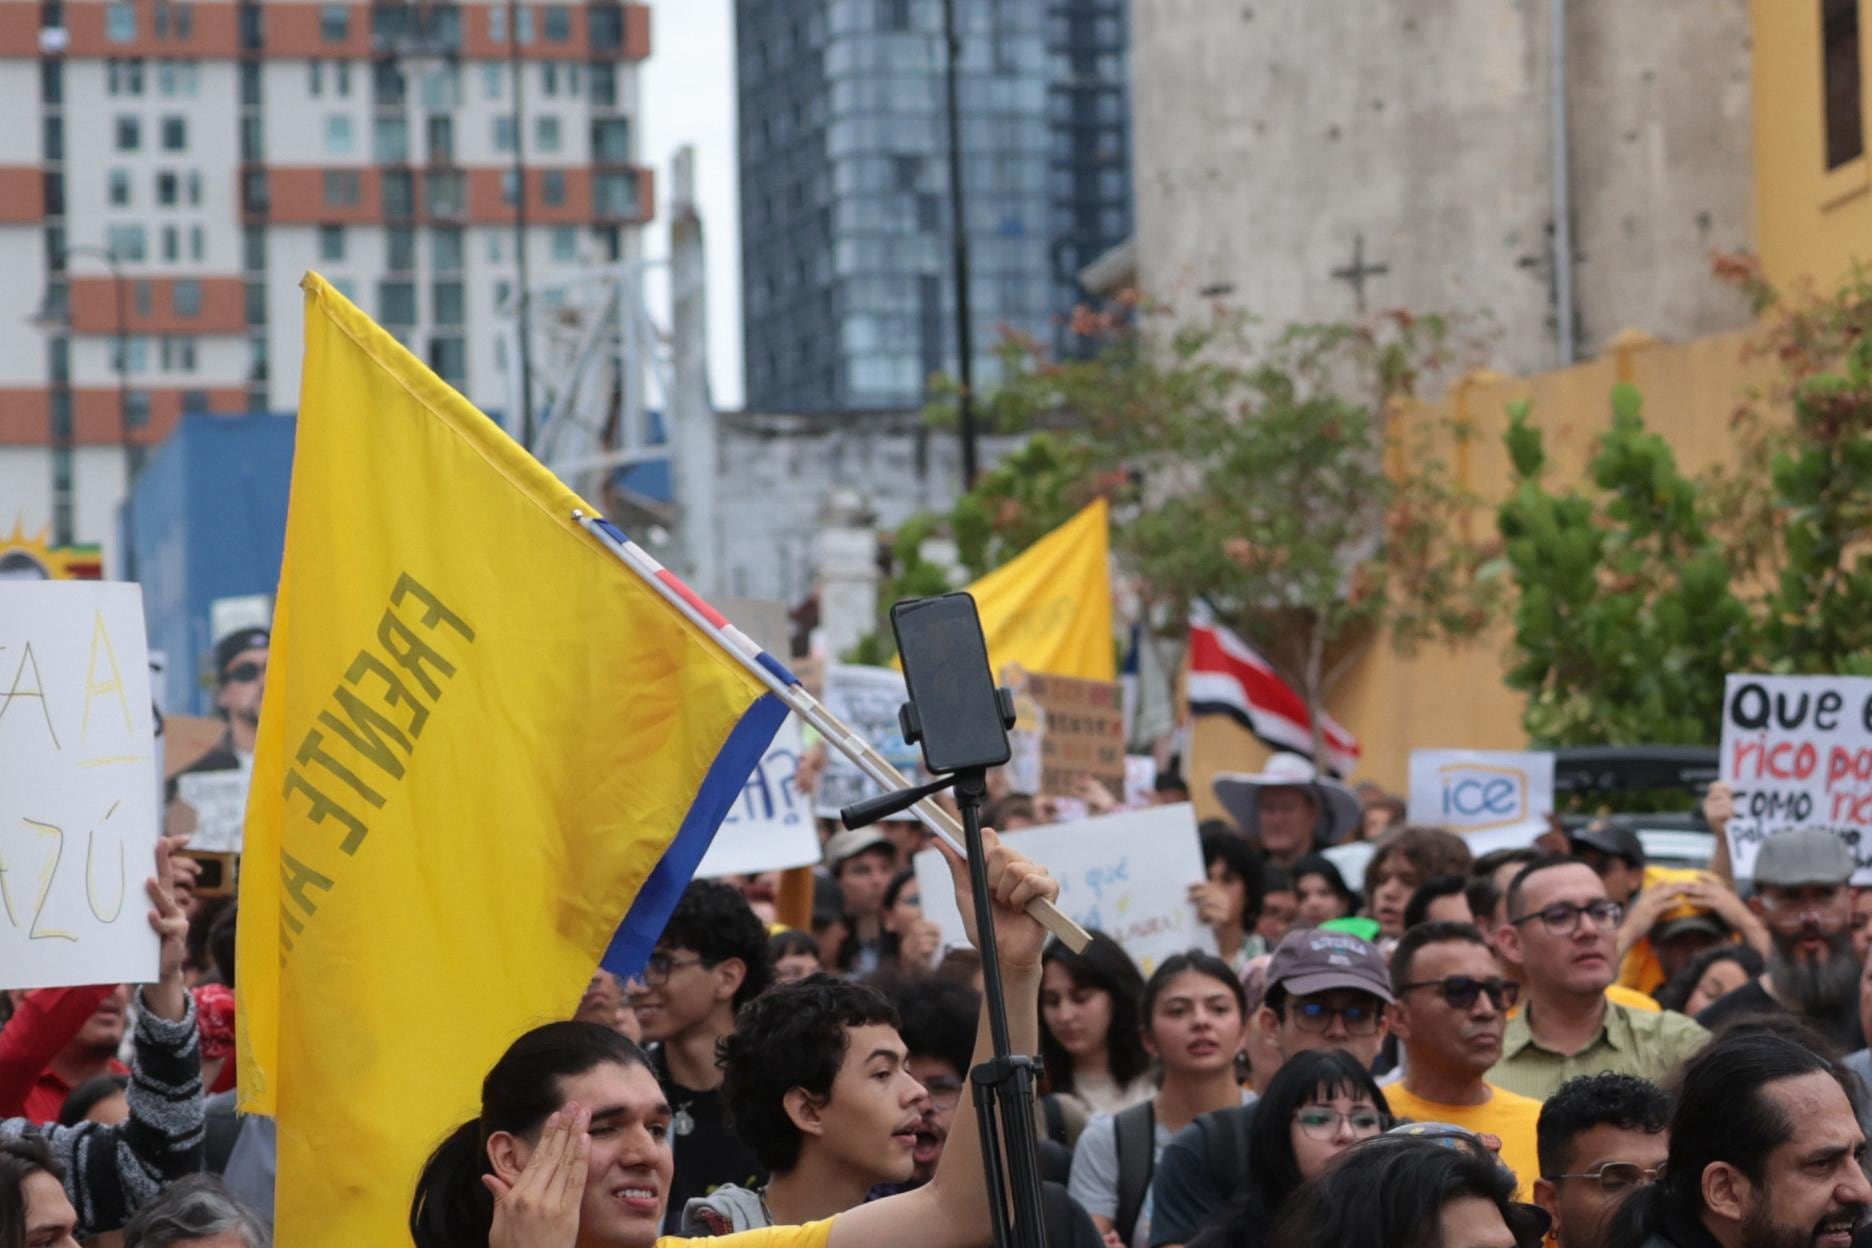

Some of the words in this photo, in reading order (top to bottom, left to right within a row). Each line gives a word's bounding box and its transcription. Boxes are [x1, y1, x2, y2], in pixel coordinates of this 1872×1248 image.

[1731, 683, 1843, 731] Que
[1732, 734, 1818, 780] rico
[1442, 778, 1516, 816] ice
